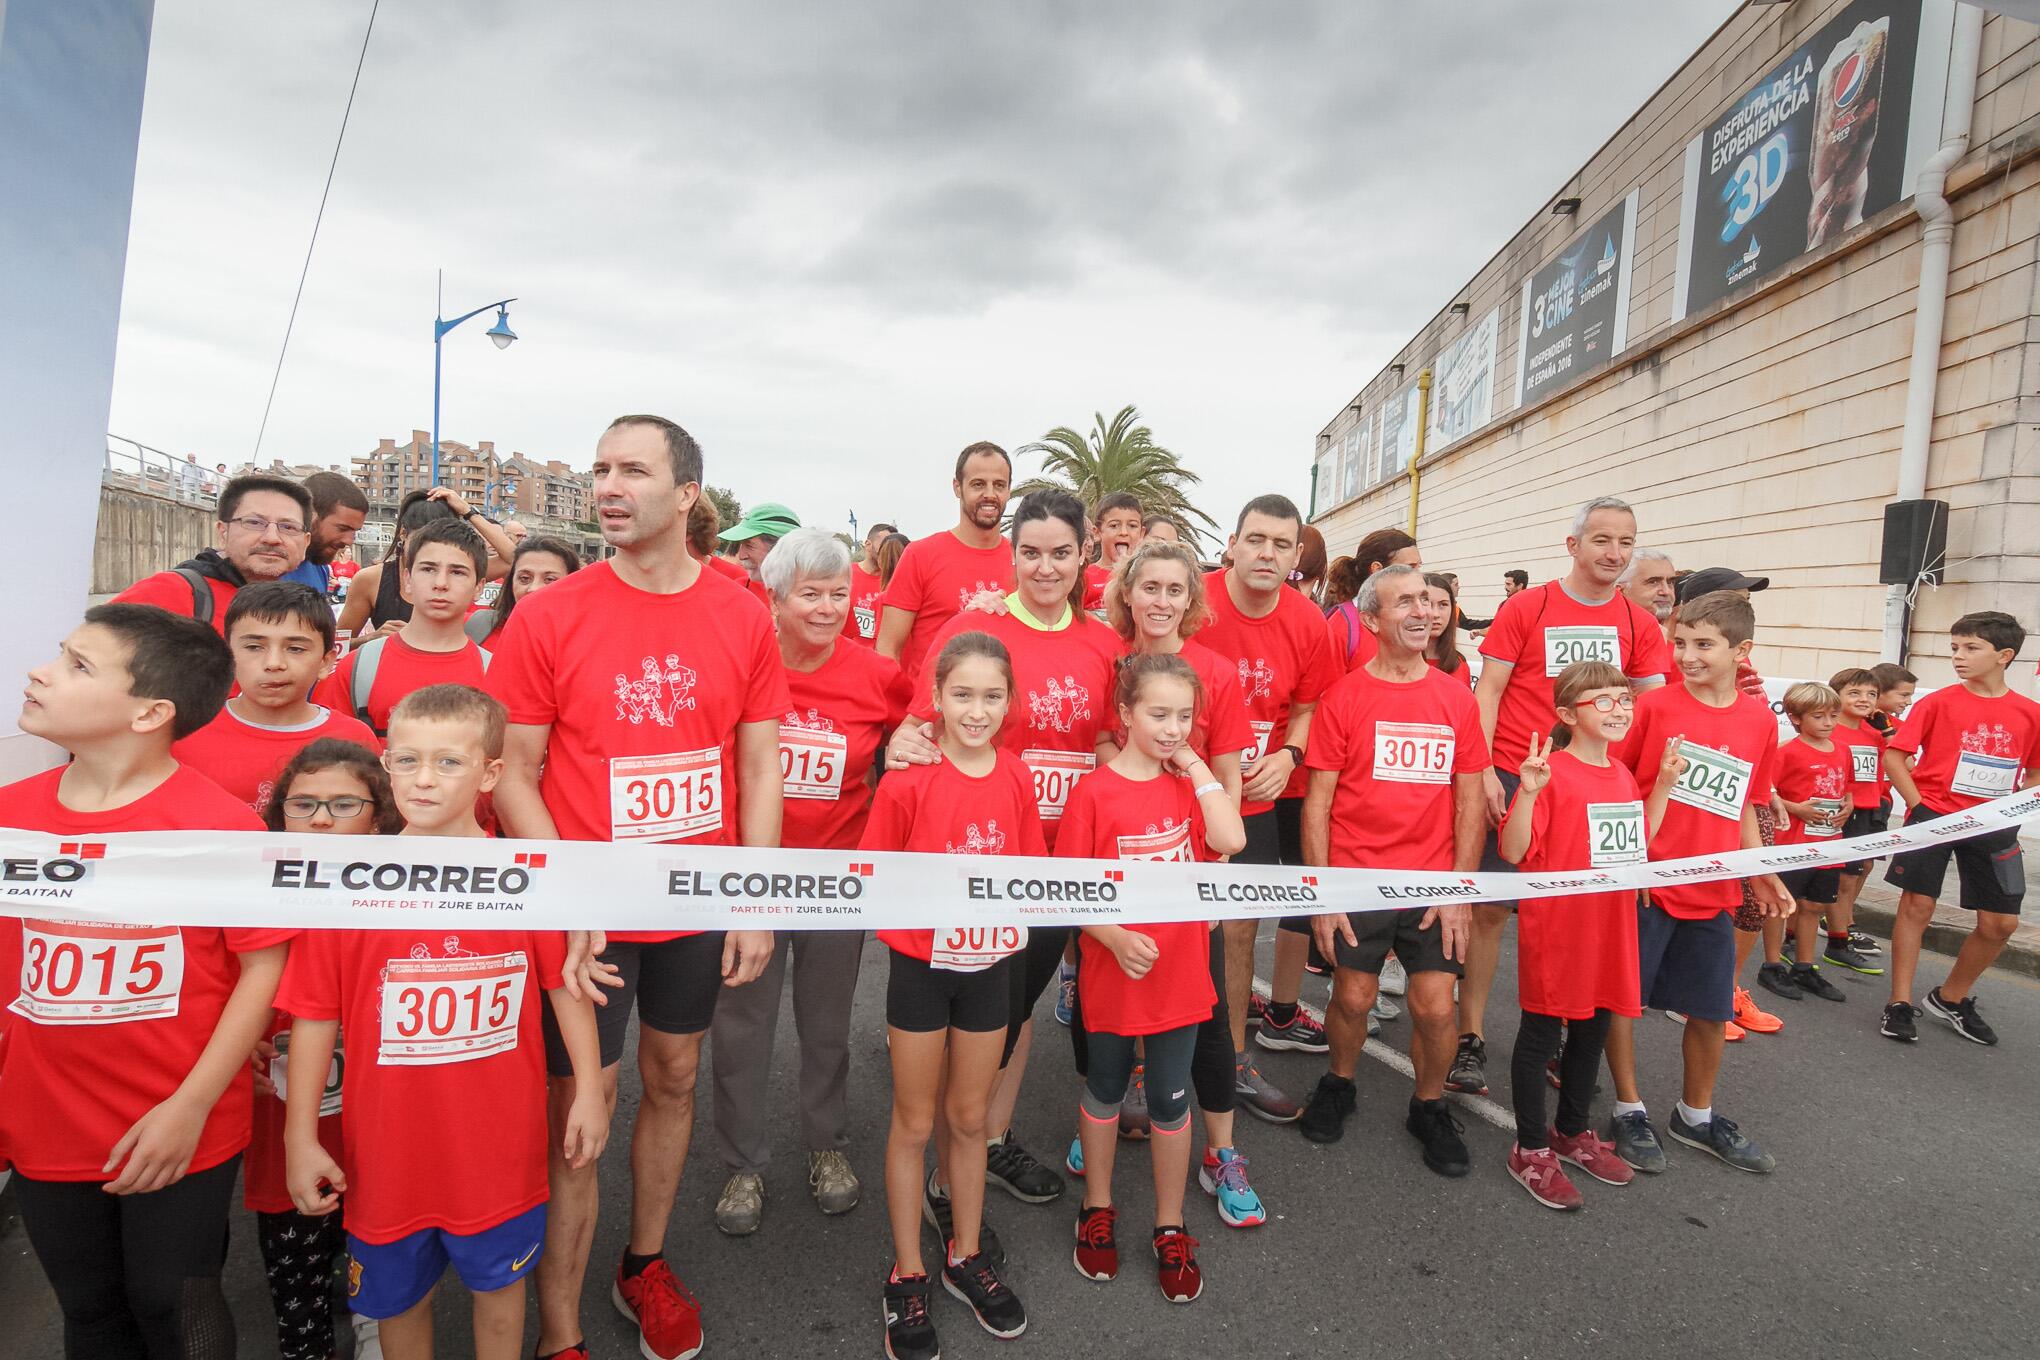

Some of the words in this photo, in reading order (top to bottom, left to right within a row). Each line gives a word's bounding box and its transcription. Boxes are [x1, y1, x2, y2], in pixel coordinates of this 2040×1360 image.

[1712, 91, 1768, 150] DISFRUTA
[1771, 70, 1791, 103] DE
[1794, 55, 1813, 85] LA
[1711, 82, 1809, 176] EXPERIENCIA
[1726, 132, 1788, 227] 3D
[1548, 269, 1574, 304] MEJOR
[1580, 271, 1613, 306] zinemak
[1545, 288, 1574, 329] CINE
[1529, 333, 1572, 370] INDEPENDIENTE
[1527, 375, 1534, 390] DE
[1534, 362, 1556, 386] ESPAÑA
[1557, 354, 1572, 373] 2016
[1555, 641, 1614, 664] 2045
[1384, 739, 1446, 770] 3015
[626, 772, 714, 820] 3015
[1676, 758, 1740, 802] 2045
[1598, 820, 1639, 850] 204
[7, 888, 73, 898] BAITAN
[271, 859, 331, 889] EL
[340, 862, 530, 895] CORREO
[668, 870, 712, 896] EL
[719, 872, 863, 900] CORREO
[968, 877, 1002, 900] EL
[1006, 878, 1117, 902] CORREO
[1197, 882, 1227, 901] EL
[1228, 884, 1318, 902] CORREO
[1377, 885, 1406, 899] EL
[1406, 886, 1481, 898] CORREO
[1527, 882, 1552, 890] EL
[1552, 878, 1618, 889] CORREO
[352, 900, 395, 909] PARTE
[400, 900, 418, 909] DE
[420, 900, 434, 909] TI
[438, 900, 472, 910] ZURE
[476, 902, 524, 911] BAITAN
[730, 906, 764, 914] PARTE
[768, 906, 781, 914] DE
[784, 906, 794, 914] TI
[796, 906, 823, 914] ZURE
[826, 906, 862, 914] BAITAN
[28, 938, 166, 996] 3015
[396, 980, 512, 1037] 3015
